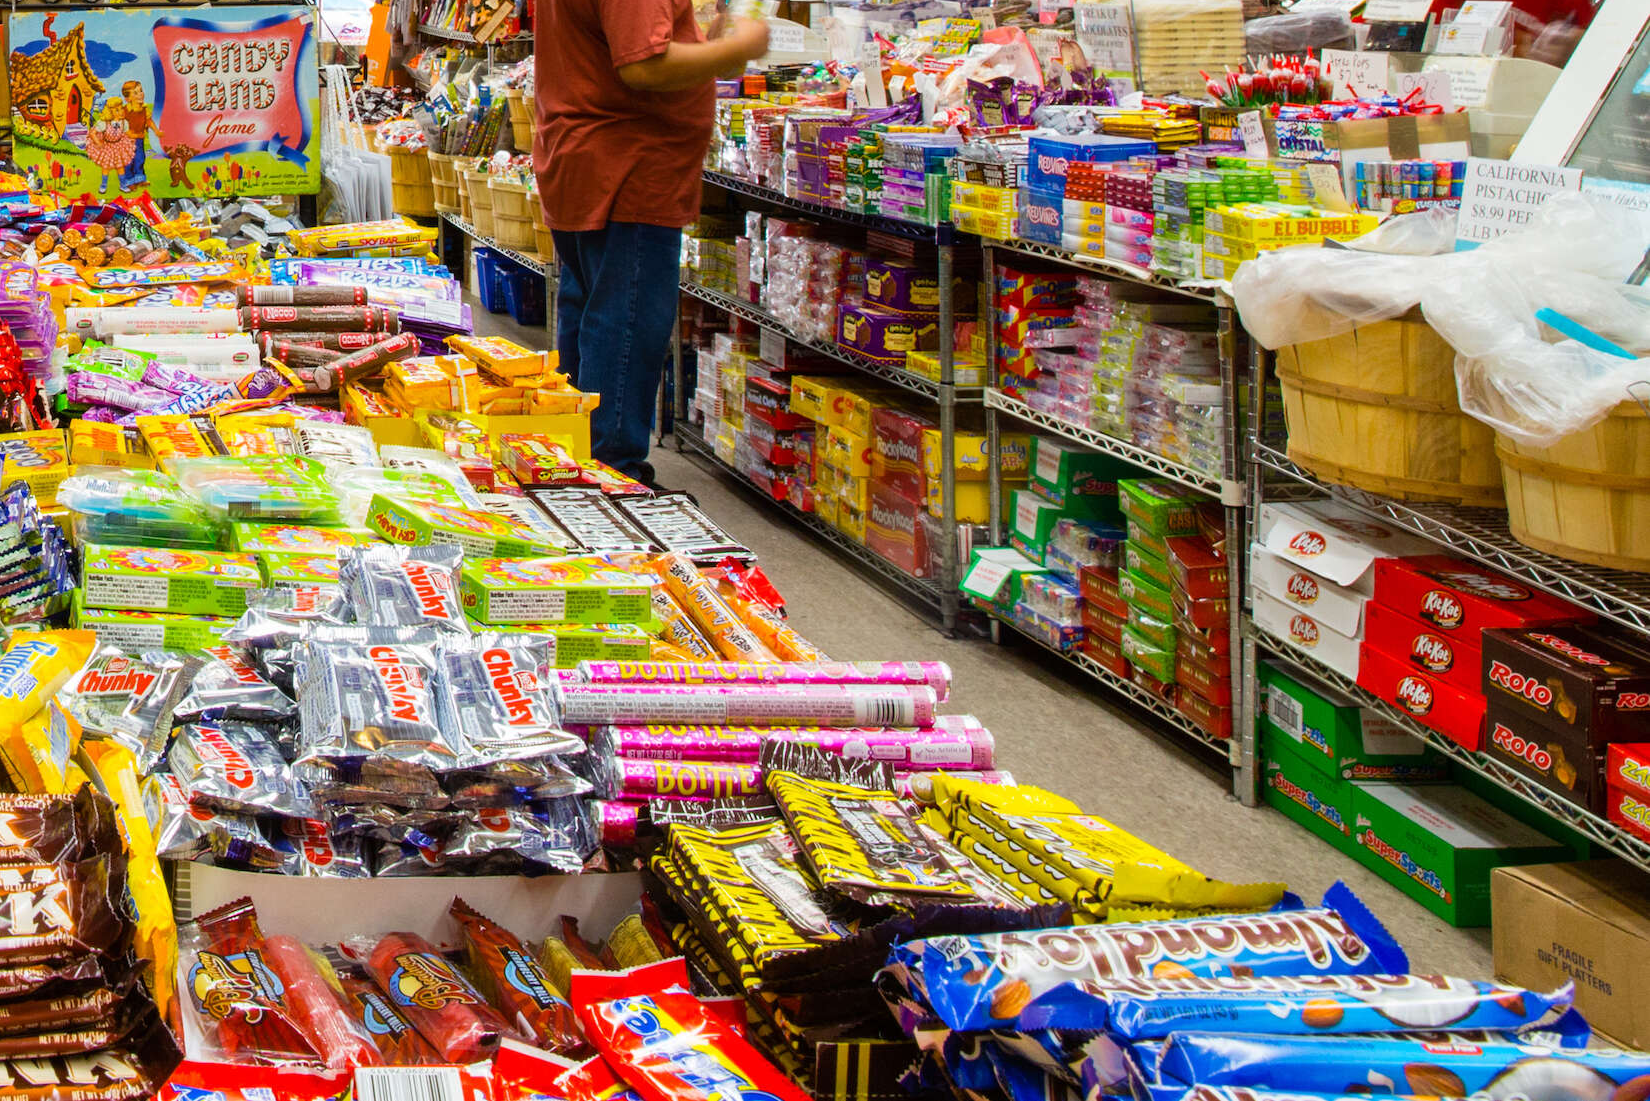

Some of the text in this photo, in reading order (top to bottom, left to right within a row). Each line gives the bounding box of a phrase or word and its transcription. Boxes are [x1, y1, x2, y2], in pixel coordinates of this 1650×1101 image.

[173, 39, 290, 74] CANDY
[189, 78, 276, 111] LAND
[203, 114, 256, 148] Game
[1279, 137, 1325, 152] CRYSTAL
[1477, 163, 1566, 188] CALIFORNIA
[1471, 203, 1504, 219] $8.99
[1274, 219, 1361, 236] EL BUBBLE
[1472, 224, 1490, 240] LB
[266, 309, 295, 319] Necco
[76, 668, 156, 696] Chunky
[480, 646, 538, 728] Chunky
[1126, 909, 1370, 968] Almond
[1537, 948, 1612, 996] GIFT PLATTERS
[1552, 942, 1594, 972] FRAGILE
[508, 950, 553, 1007] STRAWBERRY ROLLS
